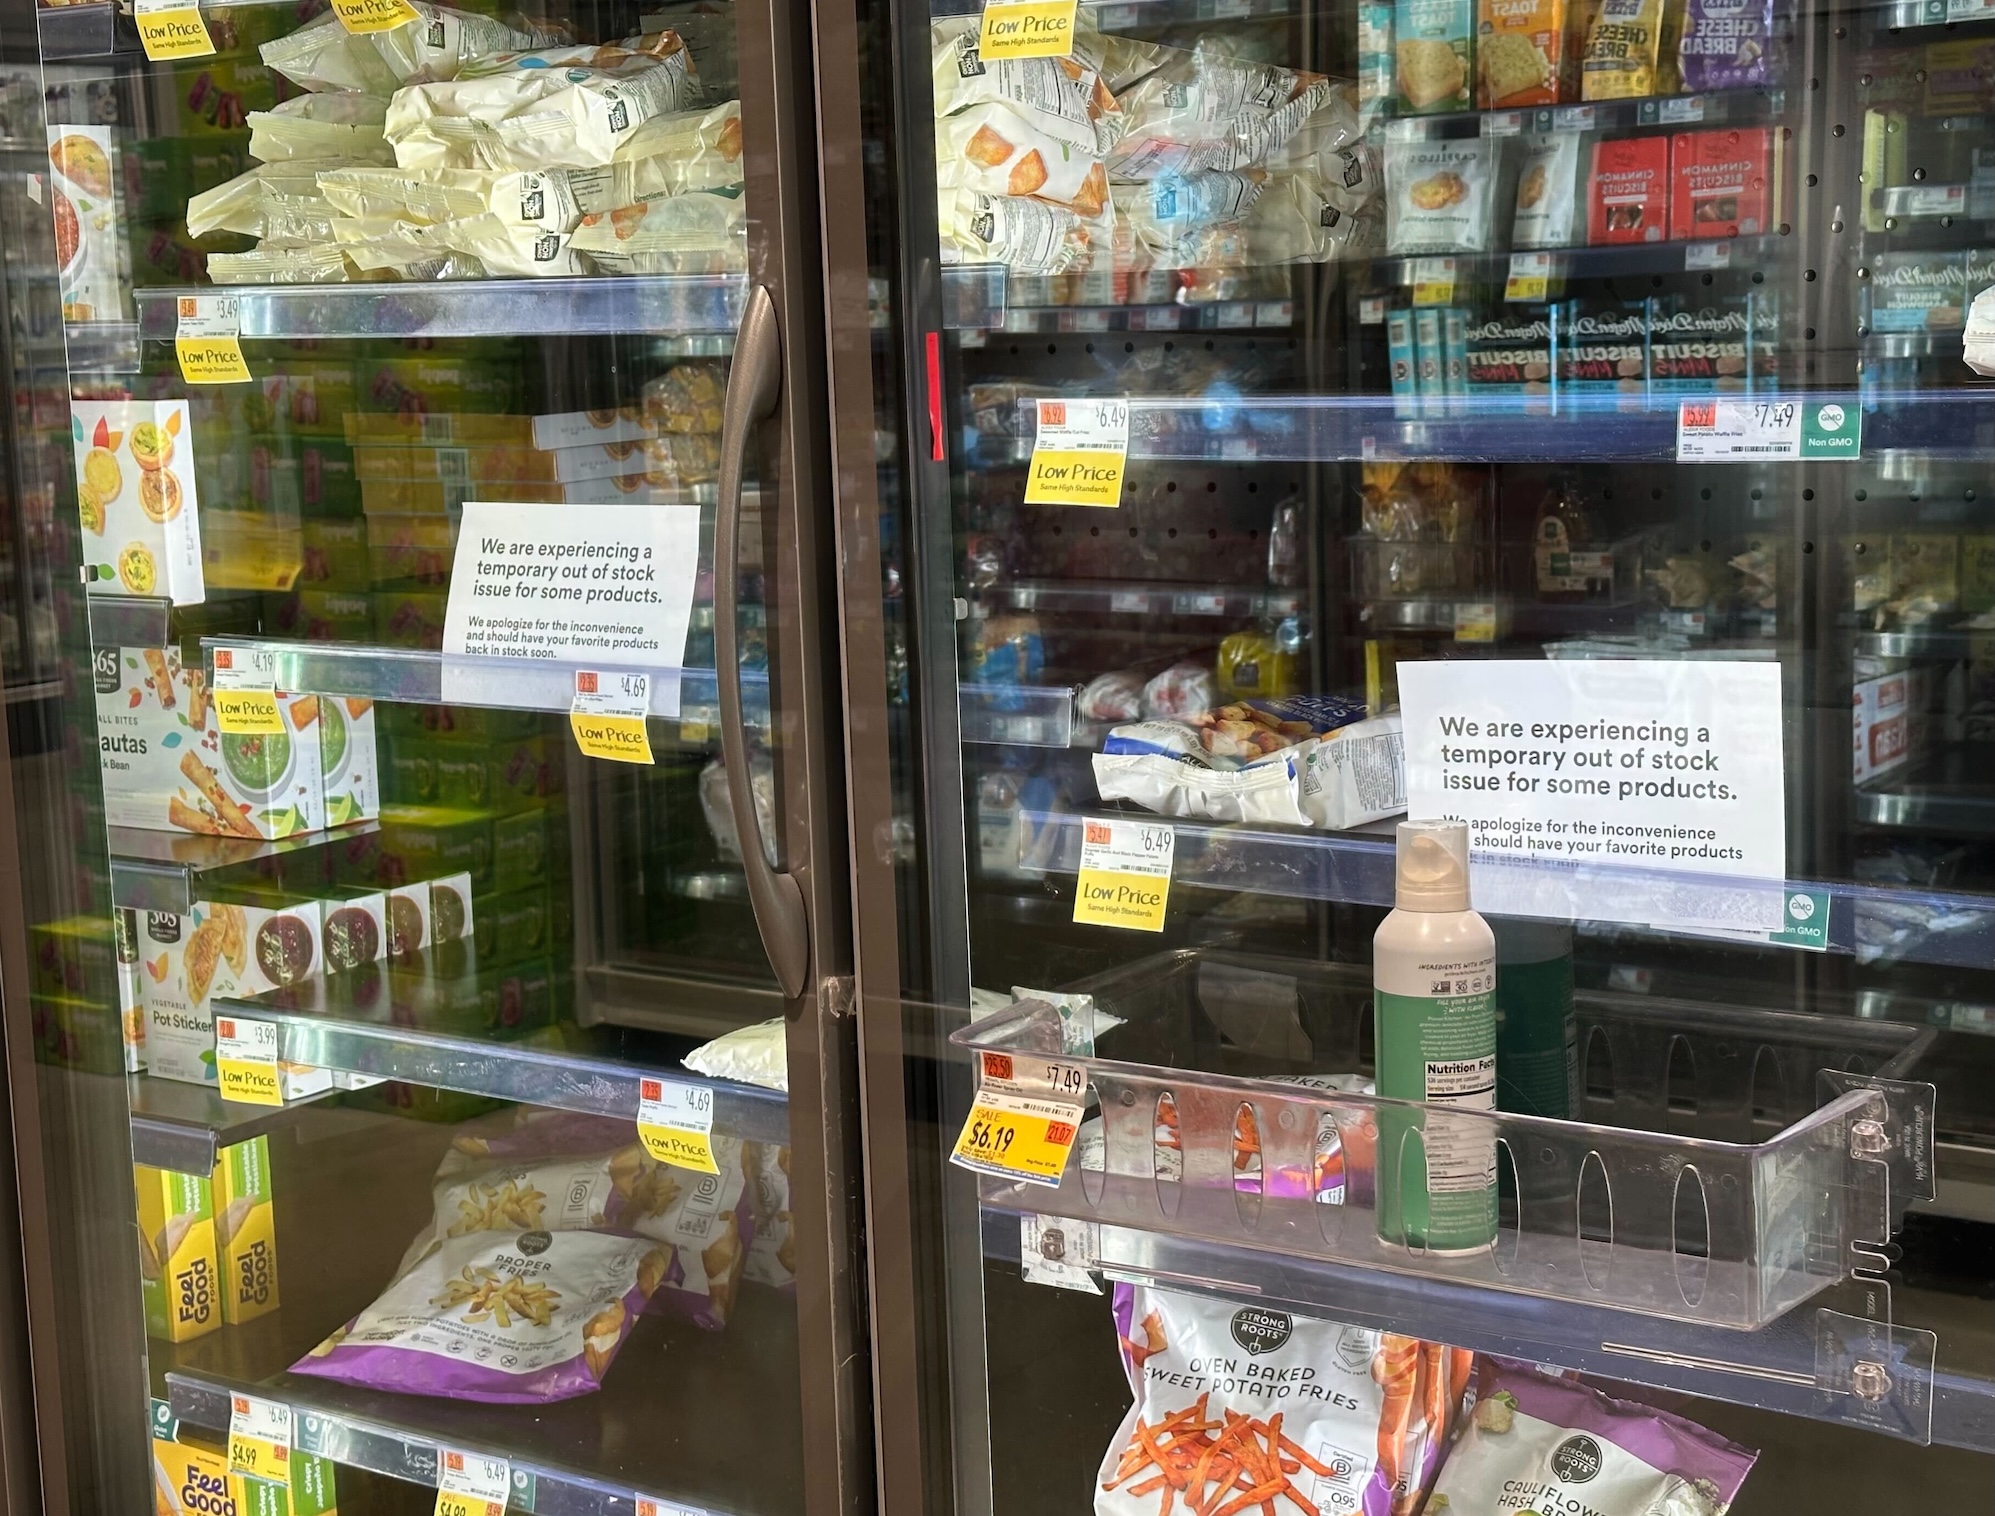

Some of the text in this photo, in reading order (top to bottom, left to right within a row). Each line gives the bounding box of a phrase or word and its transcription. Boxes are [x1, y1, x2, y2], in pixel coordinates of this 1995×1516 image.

[338, 0, 402, 16] Low Price
[143, 20, 202, 40] Low Price
[988, 16, 1067, 36] Low Price
[992, 36, 1060, 47] Same High Standards
[217, 300, 238, 319] $3.49
[182, 349, 239, 363] Low Price
[1043, 405, 1062, 422] $6.92
[1096, 406, 1127, 428] $6.49
[1754, 403, 1795, 429] $7.49
[1820, 413, 1843, 422] GMO
[1808, 438, 1853, 447] Non GMO
[1037, 463, 1117, 481] Low Price
[1040, 483, 1109, 494] Same High Standards
[481, 538, 652, 563] We are experiencing a
[477, 560, 655, 581] temporary out of stock
[473, 579, 662, 604] issue for some products.
[468, 615, 644, 635] We apologize for the inconvenience
[466, 630, 659, 650] and should have your favorite products
[465, 642, 557, 659] back in stock soon.
[252, 653, 273, 672] $4.19
[621, 677, 646, 698] $4.69
[219, 701, 275, 715] Low Price
[115, 715, 139, 726] BITES
[578, 725, 643, 743] Low Price
[1439, 716, 1710, 747] We are experiencing a
[110, 759, 130, 770] Bean
[1441, 744, 1720, 771] temporary out of stock
[1442, 768, 1738, 801] issue for some products.
[1471, 817, 1543, 834] apologize
[1546, 819, 1568, 834] for
[1572, 820, 1597, 834] the
[1601, 821, 1716, 840] inconvenience
[1141, 829, 1171, 853] $6.49
[1474, 834, 1743, 860] should have your favorite products
[1083, 883, 1160, 906] Low Price
[1087, 903, 1152, 918] Same High Standards
[1791, 902, 1812, 912] GMO
[1785, 925, 1821, 937] on GMO
[151, 999, 187, 1010] VEGETABLE
[153, 1010, 172, 1027] Pot
[255, 1026, 275, 1046] $3.99
[222, 1069, 276, 1087] Low Price
[1427, 1063, 1476, 1074] Nutrition
[1046, 1065, 1081, 1095] $7.49
[685, 1089, 710, 1112] $4.69
[976, 1109, 1003, 1123] SALE
[644, 1133, 707, 1156] Low Price
[968, 1119, 1015, 1153] $6.19
[250, 1239, 269, 1305] Good
[495, 1254, 552, 1271] PROPER
[498, 1263, 539, 1277] FRIES
[208, 1266, 216, 1303] FOODS
[237, 1252, 255, 1304] Feel
[176, 1270, 194, 1323] Feel
[191, 1257, 211, 1324] Good
[1240, 1311, 1286, 1329] STRONG
[1240, 1324, 1280, 1339] ROOTS
[1189, 1358, 1315, 1382] OVEN BAKED
[1144, 1366, 1359, 1411] SWEET POTATO FRIES
[268, 1405, 288, 1425] $6.49
[232, 1443, 257, 1466] $4.99
[1558, 1455, 1588, 1473] ROOTS
[1560, 1445, 1598, 1466] STRONG
[186, 1463, 230, 1499] Feel
[483, 1461, 505, 1481] $6.49
[180, 1484, 238, 1516] Good
[1331, 1492, 1356, 1508] 0.95
[1497, 1494, 1536, 1509] HASH
[1503, 1480, 1610, 1516] CAULIFLOW
